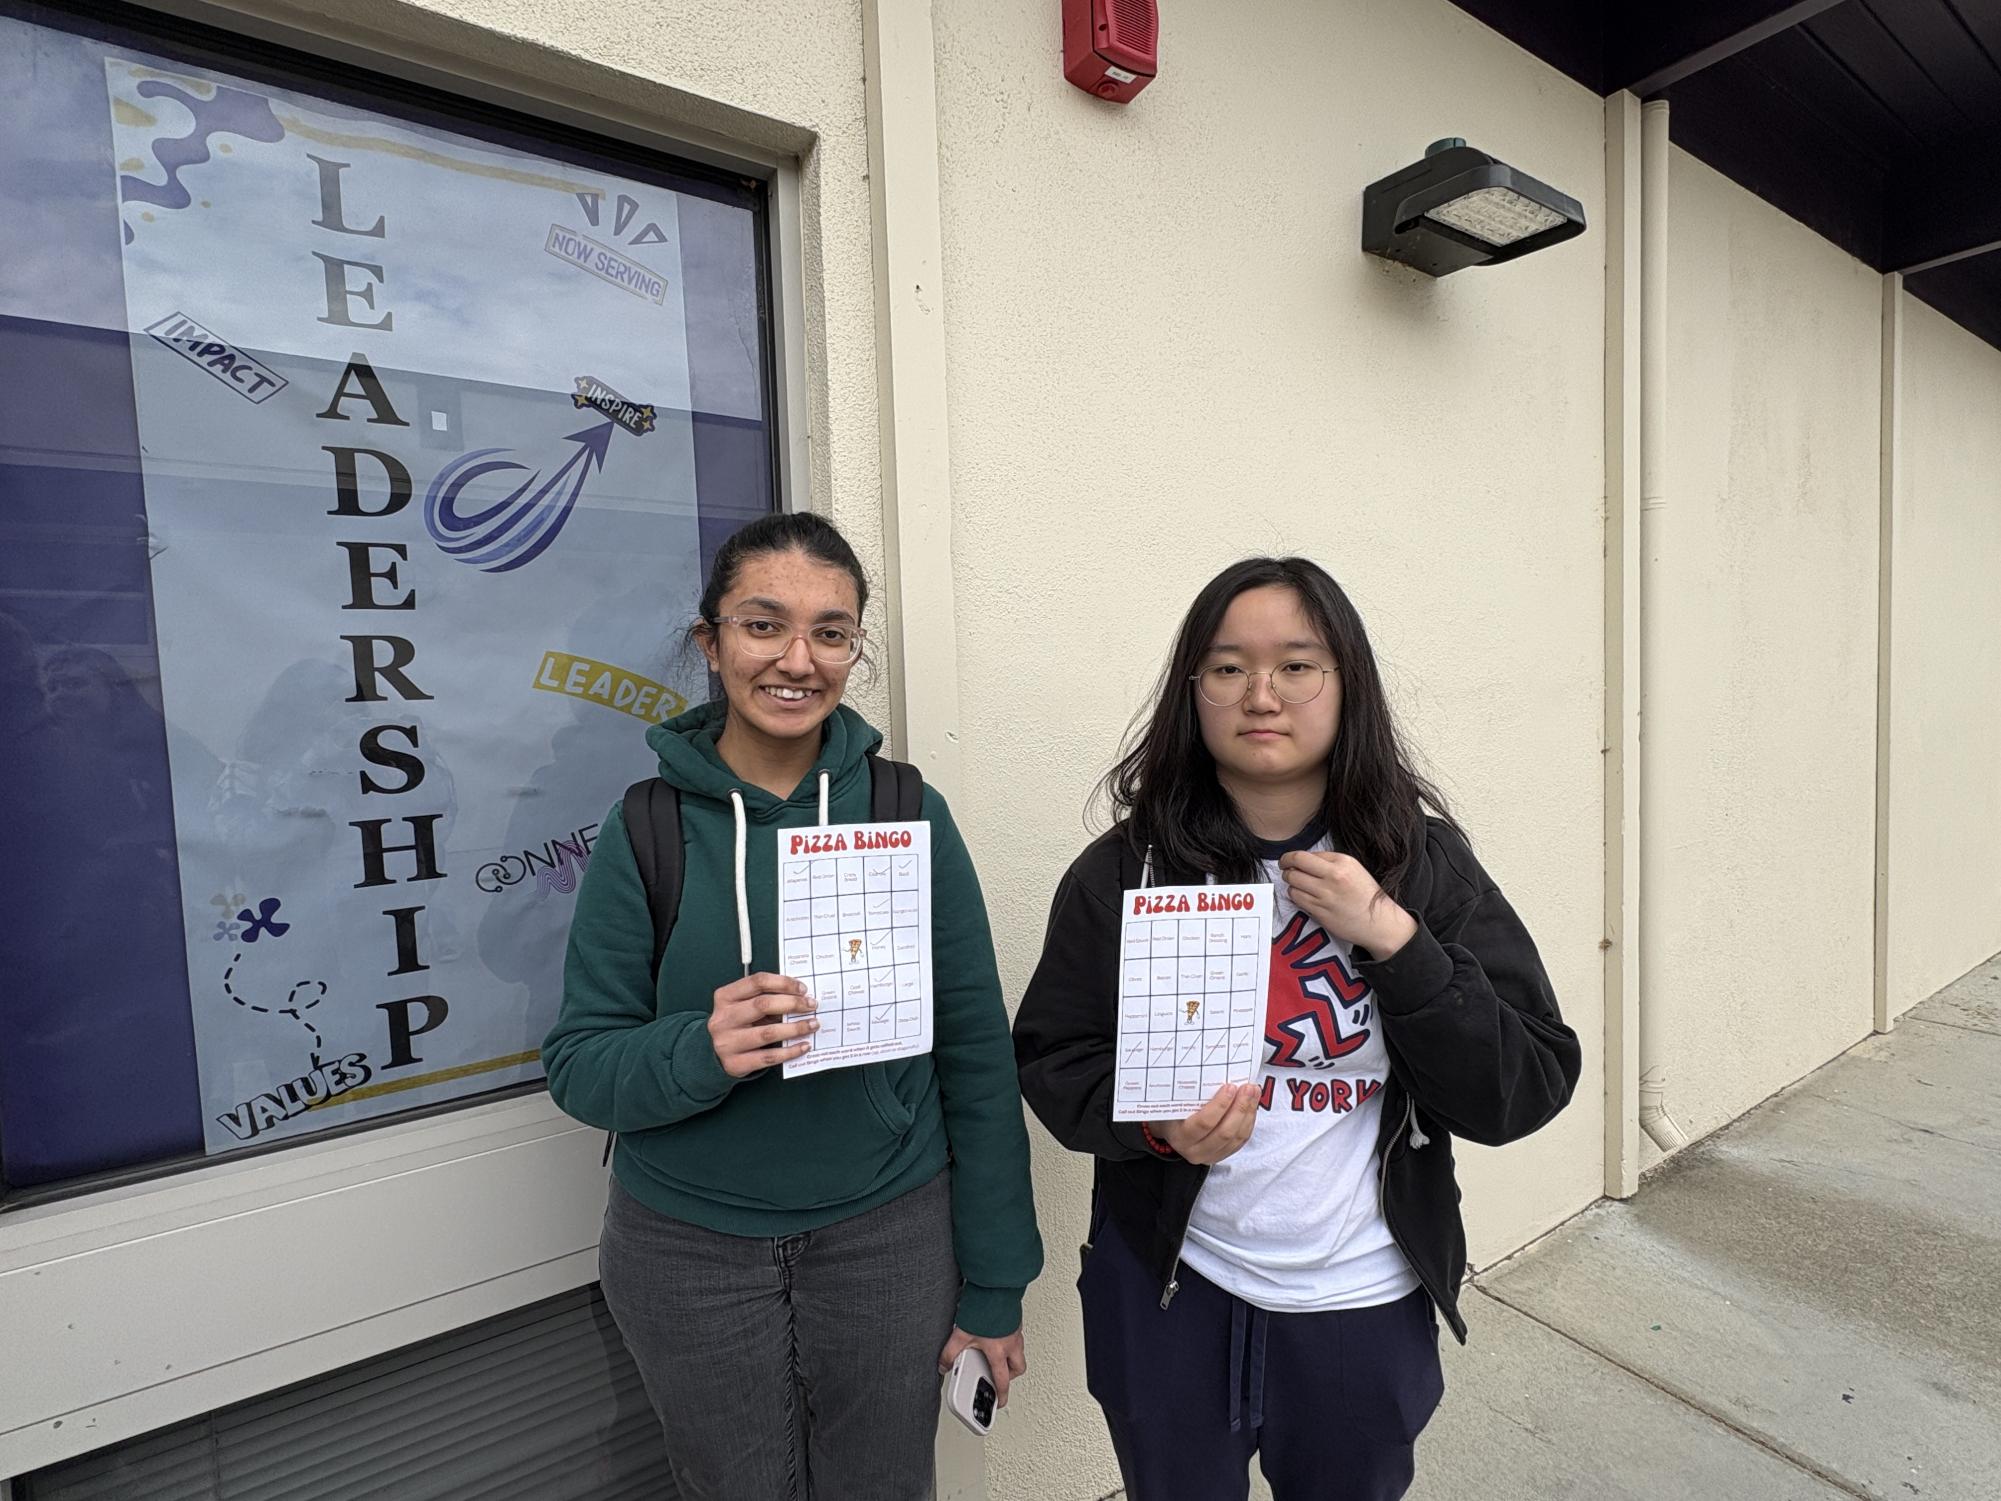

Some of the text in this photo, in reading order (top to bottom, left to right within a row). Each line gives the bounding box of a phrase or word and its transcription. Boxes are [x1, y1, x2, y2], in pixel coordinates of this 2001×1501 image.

[552, 232, 662, 299] NOW SERVING
[164, 319, 276, 394] IMPACT
[587, 384, 643, 428] INSPIRE
[306, 153, 449, 1070] LEADERSHIP
[539, 657, 677, 721] LEADER
[216, 1053, 372, 1140] VALUES
